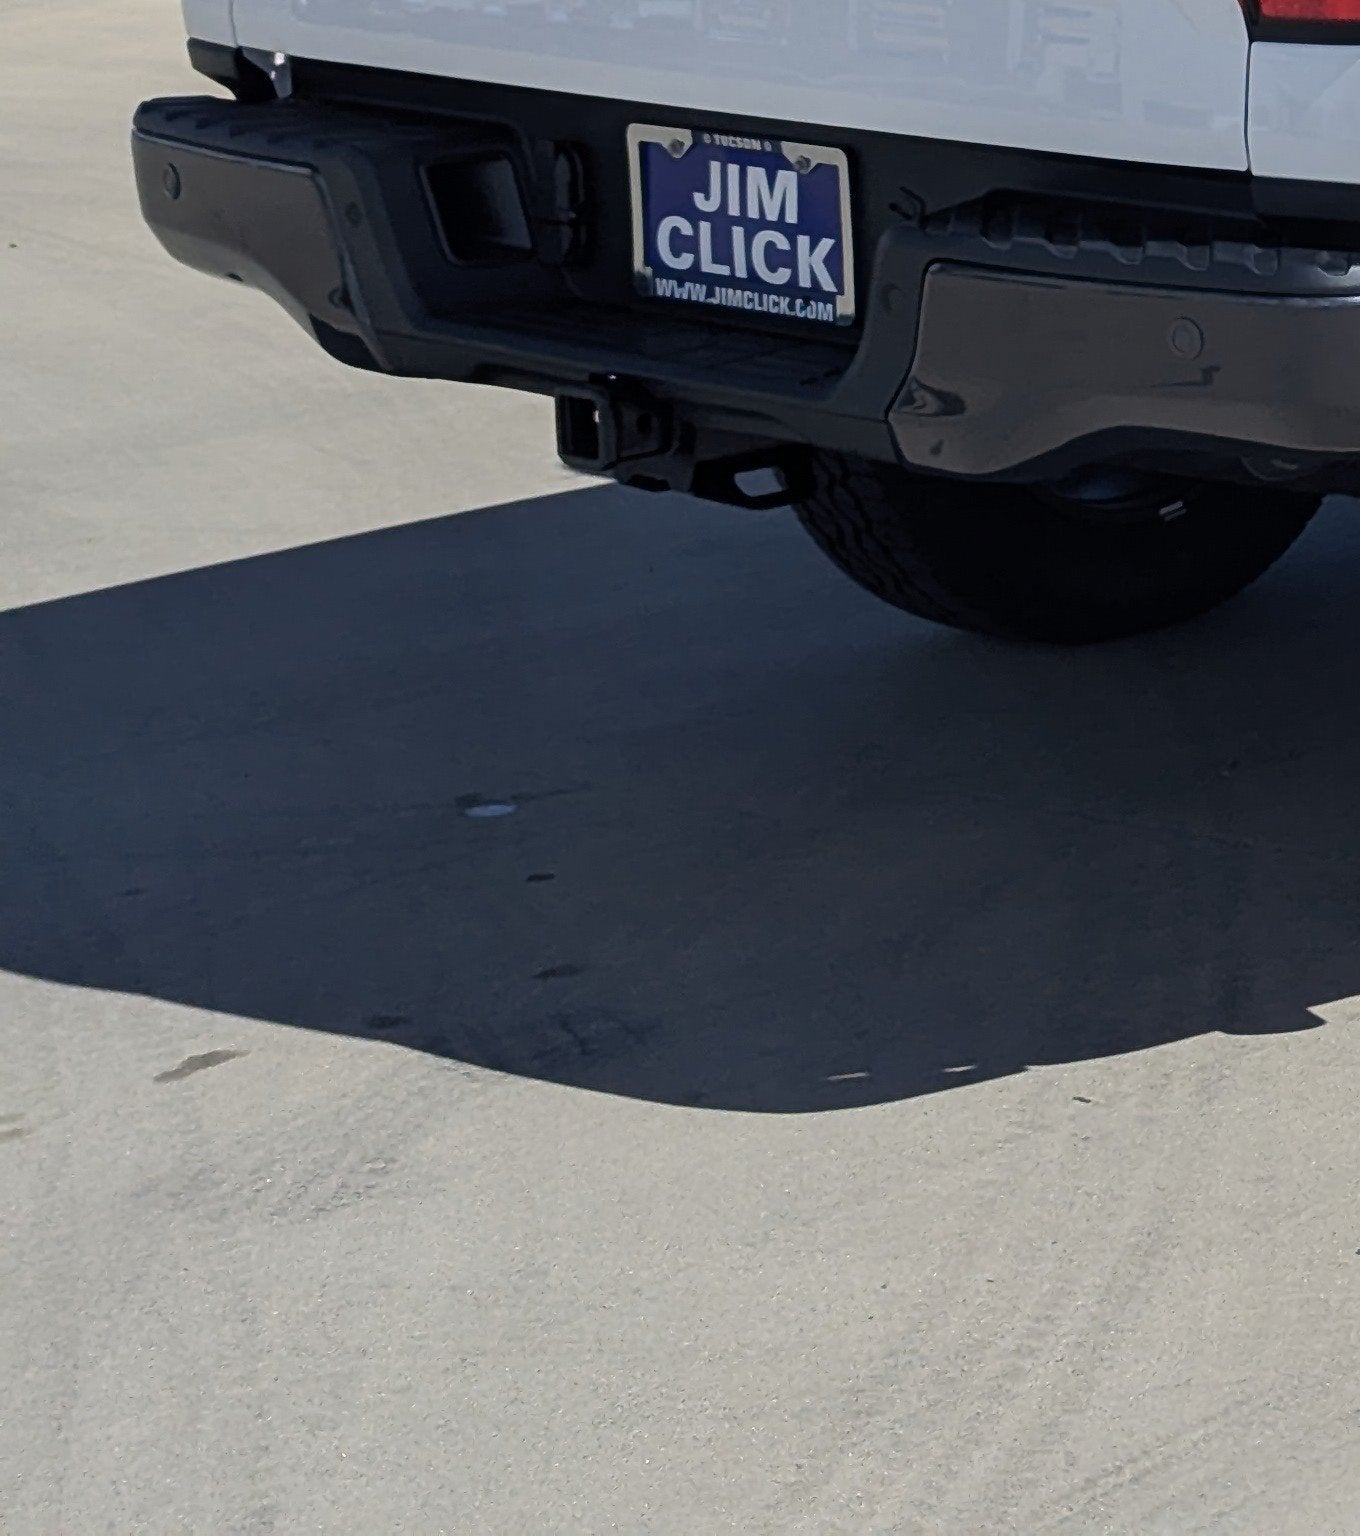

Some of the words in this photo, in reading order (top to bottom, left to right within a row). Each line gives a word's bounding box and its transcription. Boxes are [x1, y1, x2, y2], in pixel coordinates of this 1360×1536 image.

[714, 133, 762, 151] TUCSON
[692, 159, 799, 224] JIM
[656, 215, 838, 293] CLICK
[655, 277, 835, 322] WWW.JIMCLICK.COM
